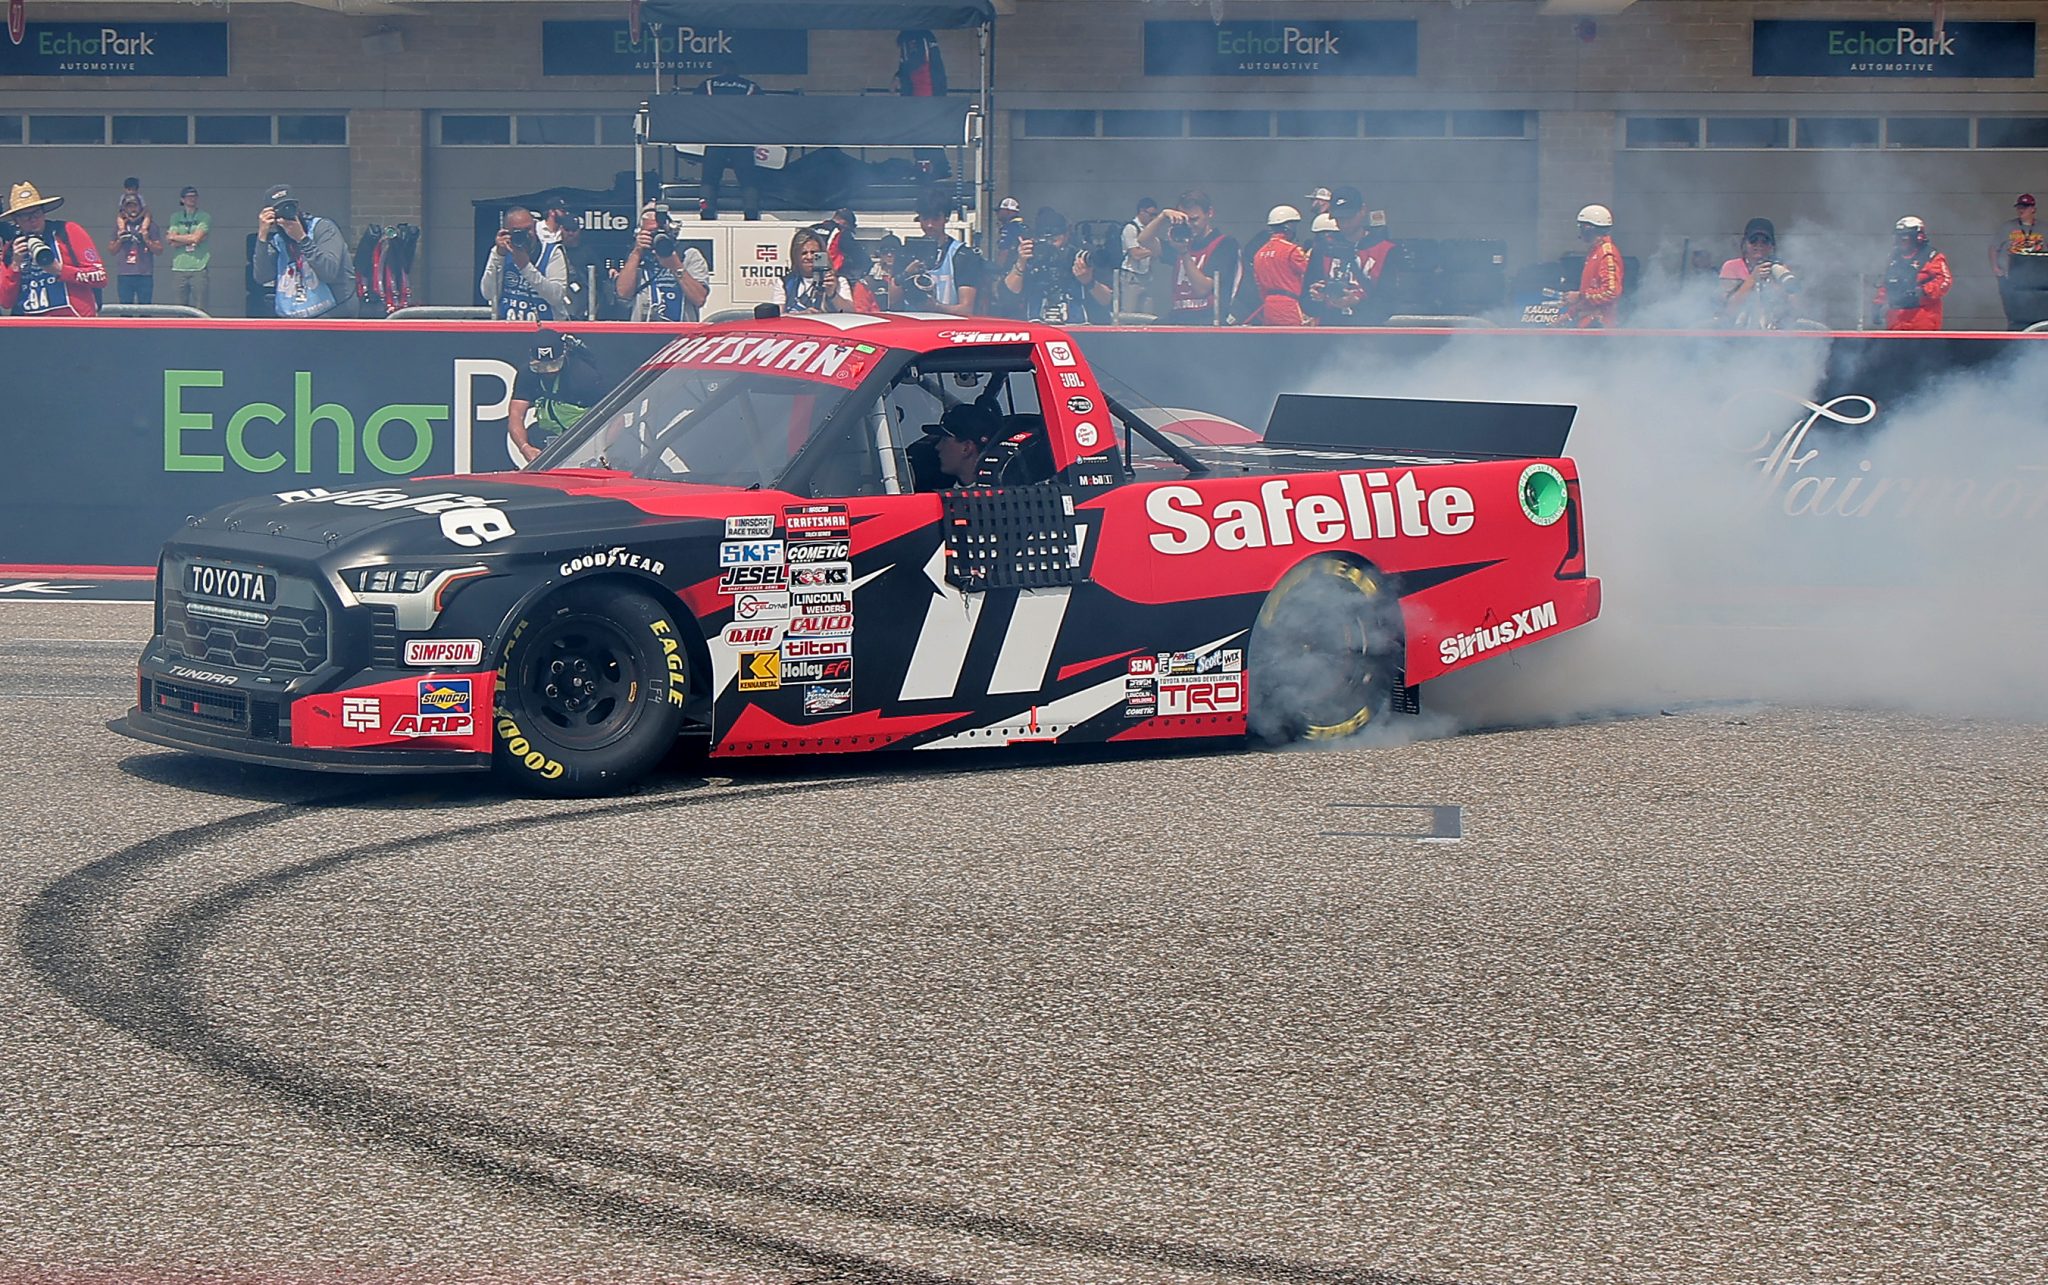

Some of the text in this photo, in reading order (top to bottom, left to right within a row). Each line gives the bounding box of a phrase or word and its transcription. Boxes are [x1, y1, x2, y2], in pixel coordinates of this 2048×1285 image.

[39, 28, 155, 55] EchoPark
[1217, 27, 1339, 54] EchoPark
[1828, 27, 1954, 55] EchoPark
[1850, 63, 1933, 71] AUTOMOTIVE
[745, 278, 778, 287] GARA
[951, 332, 1030, 343] HEIM
[1059, 372, 1085, 388] JBL
[1146, 471, 1476, 555] Safelite
[737, 518, 768, 527] NASCAR
[787, 516, 846, 528] CRAFTSMAN
[747, 527, 769, 535] TRUCK
[723, 544, 780, 562] SKF
[788, 542, 848, 560] COMETIC
[559, 547, 665, 576] GOODYEAR
[721, 565, 787, 585] JESEL
[791, 567, 849, 587] KOOKS
[192, 566, 266, 602] TOYOTA
[796, 593, 842, 604] LINCOLN
[806, 604, 847, 614] WELDERS
[790, 616, 853, 633] CALICO
[1439, 601, 1558, 667] SiriusXM
[410, 644, 475, 660] SIMPSON
[785, 641, 847, 656] tilton
[649, 619, 686, 709] EAGLE
[1223, 651, 1240, 663] WIX
[781, 662, 823, 680] Holley
[1131, 659, 1152, 672] SEM
[168, 665, 239, 685] TUNDRA
[740, 681, 777, 689] KENNAMETAL
[423, 693, 468, 703] SUNOCO
[1160, 682, 1239, 712] TRD
[392, 716, 472, 732] ARP
